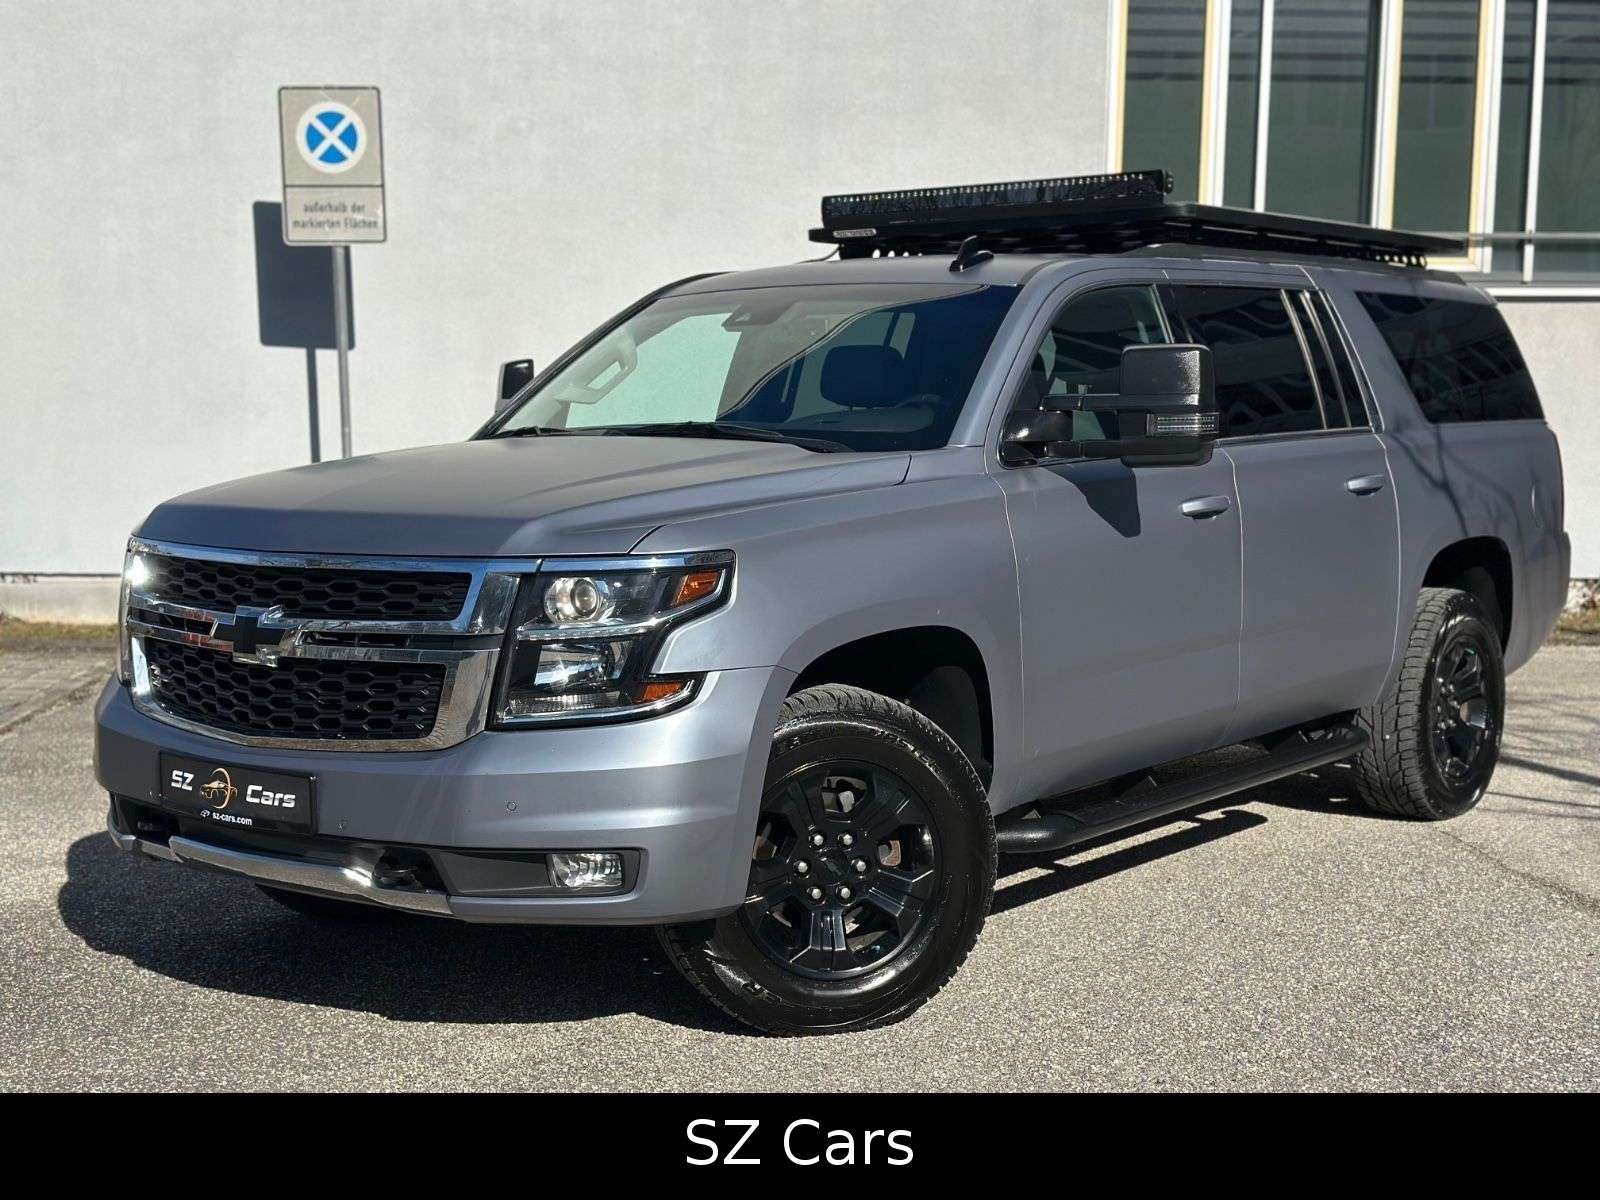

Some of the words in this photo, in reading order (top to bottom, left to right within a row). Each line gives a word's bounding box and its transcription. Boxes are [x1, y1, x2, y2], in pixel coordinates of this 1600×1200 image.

[351, 203, 366, 213] der
[292, 218, 340, 228] markierten
[344, 218, 378, 228] Flächen
[171, 770, 195, 791] SZ
[245, 784, 296, 808] Cars
[212, 811, 252, 826] sz-cars.com
